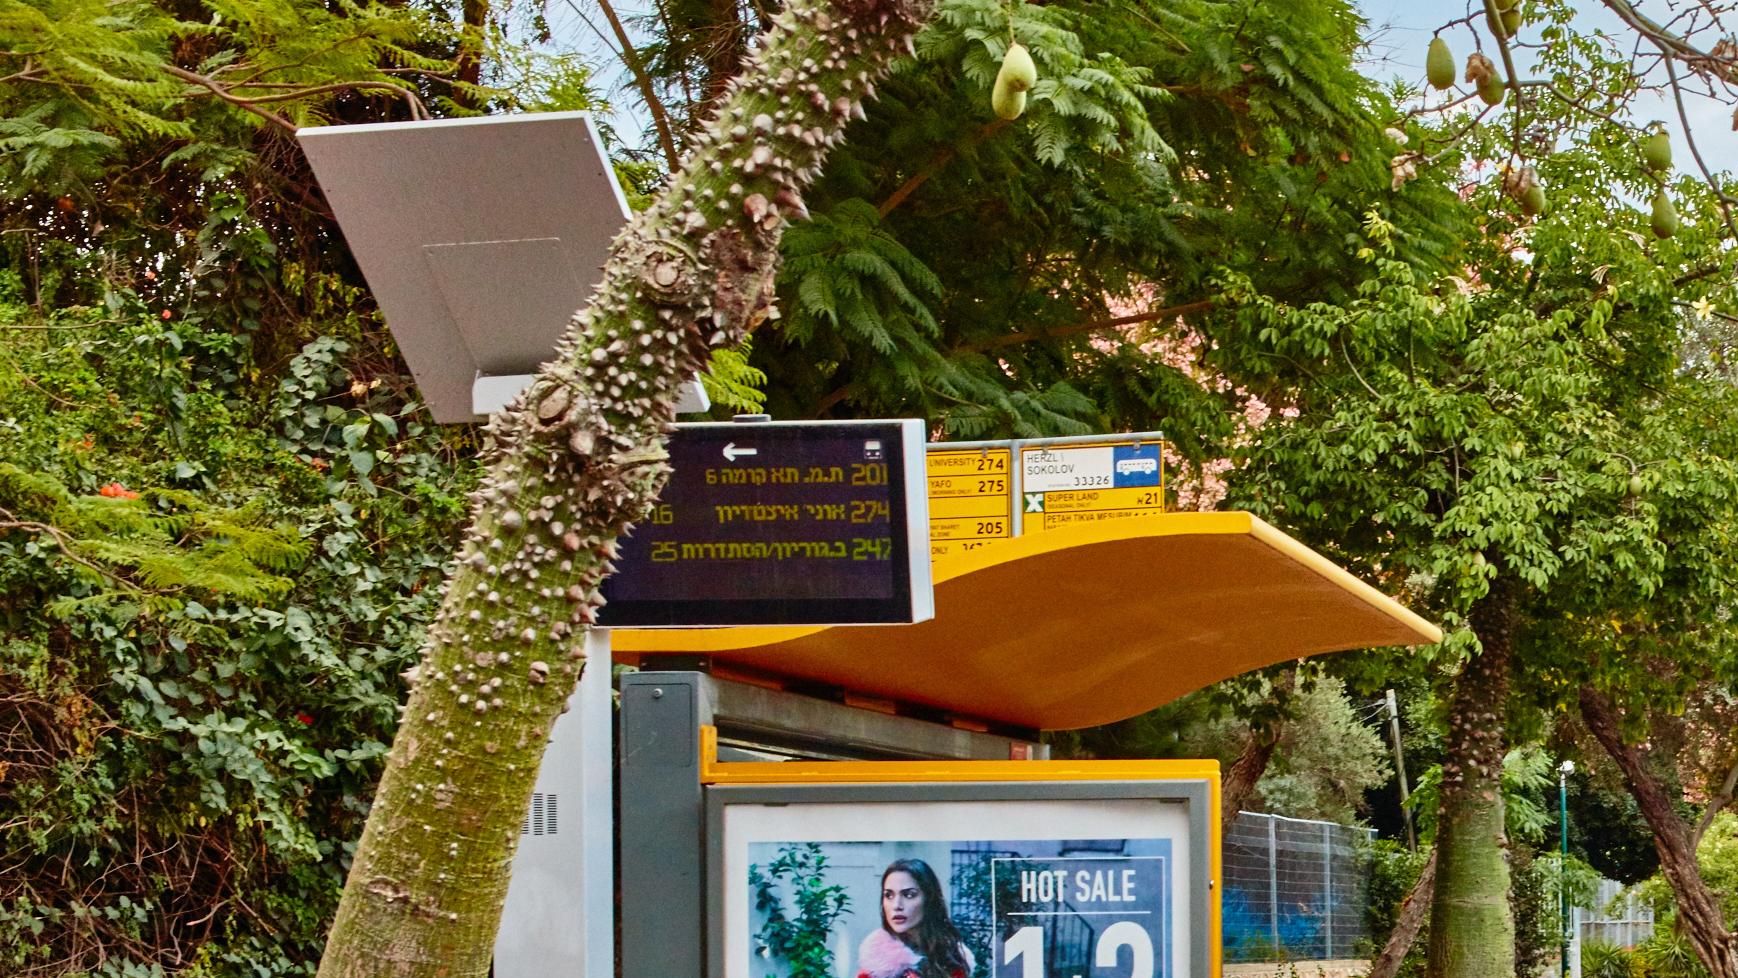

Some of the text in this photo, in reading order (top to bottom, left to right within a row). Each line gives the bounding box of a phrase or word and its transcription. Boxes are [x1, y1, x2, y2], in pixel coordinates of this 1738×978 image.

[1027, 453, 1057, 463] HERZL
[977, 458, 1004, 471] 274
[1027, 464, 1075, 475] SOKOLOV
[850, 463, 889, 486] 201
[978, 480, 1004, 493] 275
[1074, 475, 1110, 487] 33326
[1047, 493, 1073, 503] SUPER
[1076, 492, 1099, 501] LAND
[850, 501, 891, 524] 274
[976, 522, 1003, 534] 205
[1021, 869, 1137, 903] HOT SALE
